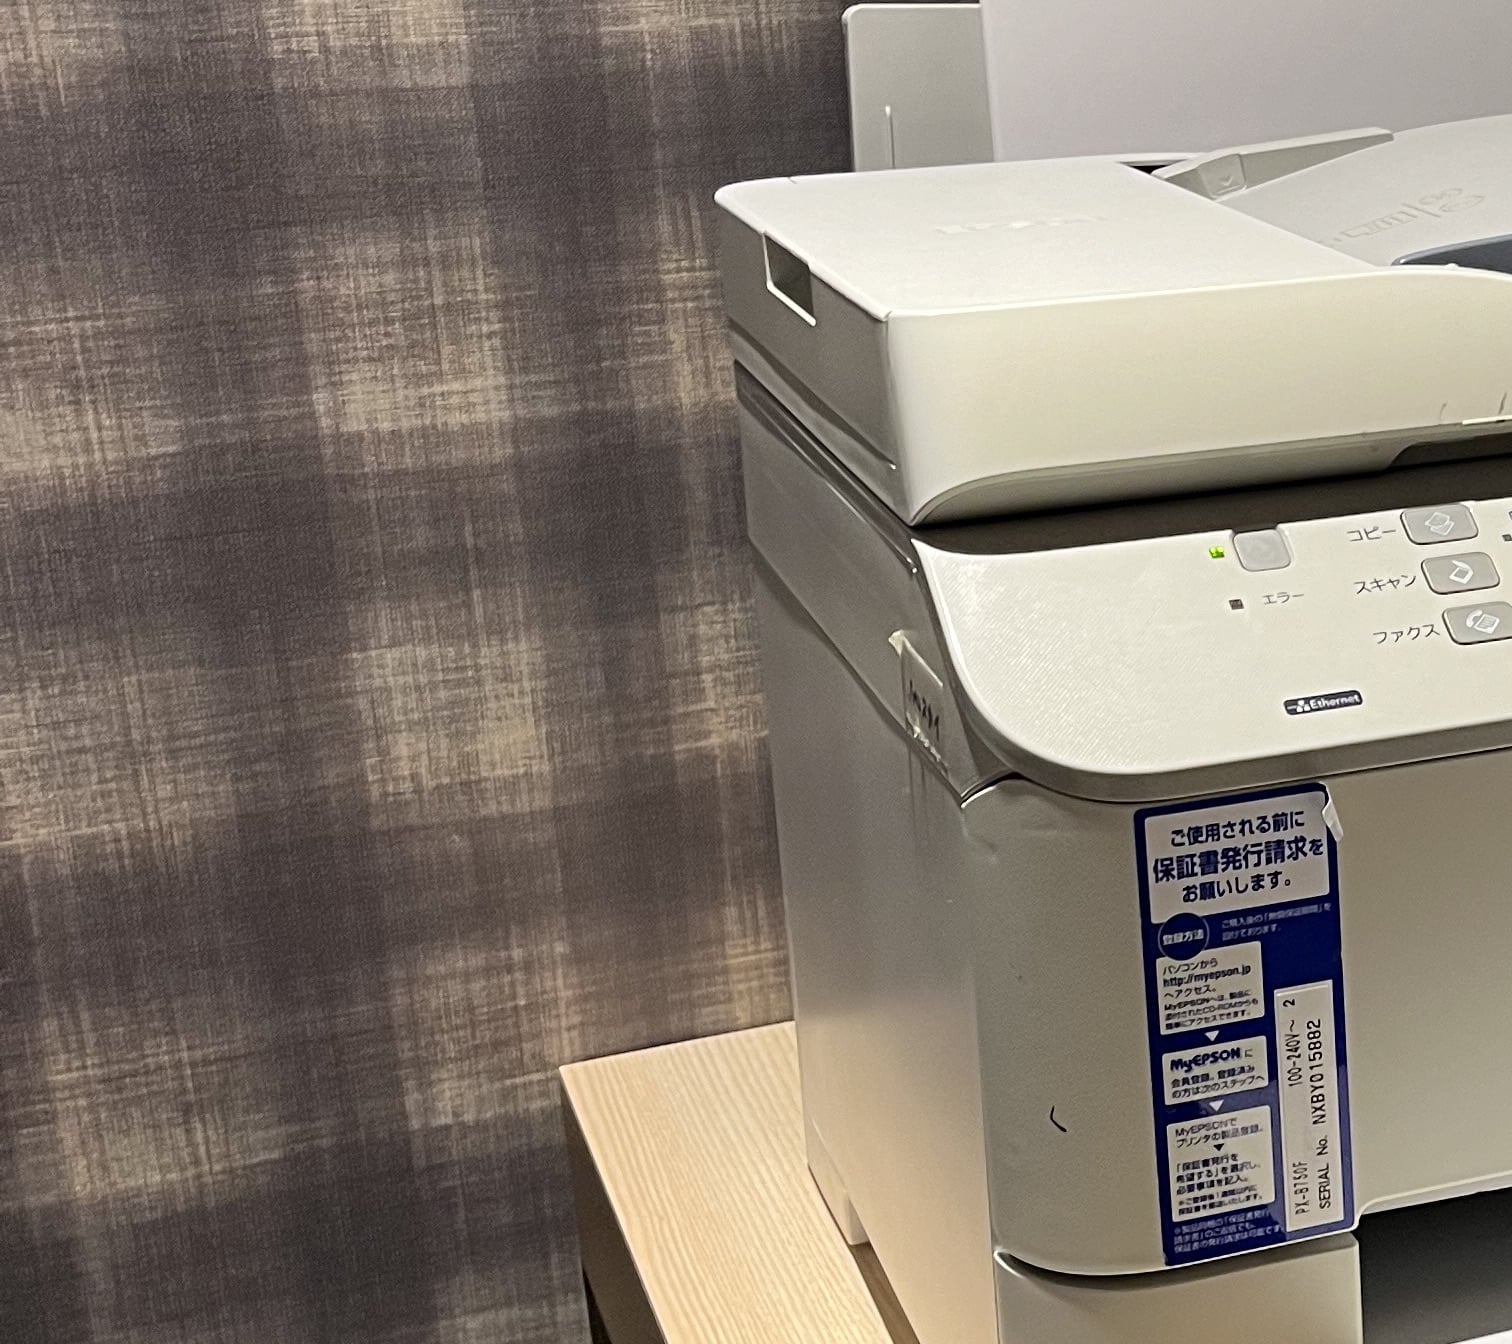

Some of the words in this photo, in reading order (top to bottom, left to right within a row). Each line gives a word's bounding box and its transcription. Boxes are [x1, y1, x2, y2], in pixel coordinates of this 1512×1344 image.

[1347, 526, 1396, 542] コピー
[1354, 574, 1417, 595] スキャン
[1262, 592, 1304, 605] エラー
[1372, 624, 1440, 645] ファクス
[1309, 693, 1360, 710] Ethernet
[1171, 811, 1304, 847] ご使用される前に
[1153, 835, 1323, 883] 保証書発行請求を
[1183, 871, 1291, 903] お願いします。
[1163, 958, 1218, 976] パソコンから
[1163, 964, 1251, 988] http://myepson.jp
[1283, 998, 1295, 1007] 2
[1170, 1047, 1240, 1073] MyEPSON
[1307, 1018, 1327, 1125] NXBY015882
[1317, 1135, 1328, 1156] No.
[1292, 1161, 1310, 1215] PX-B750F
[1319, 1163, 1331, 1209] SERIAL
